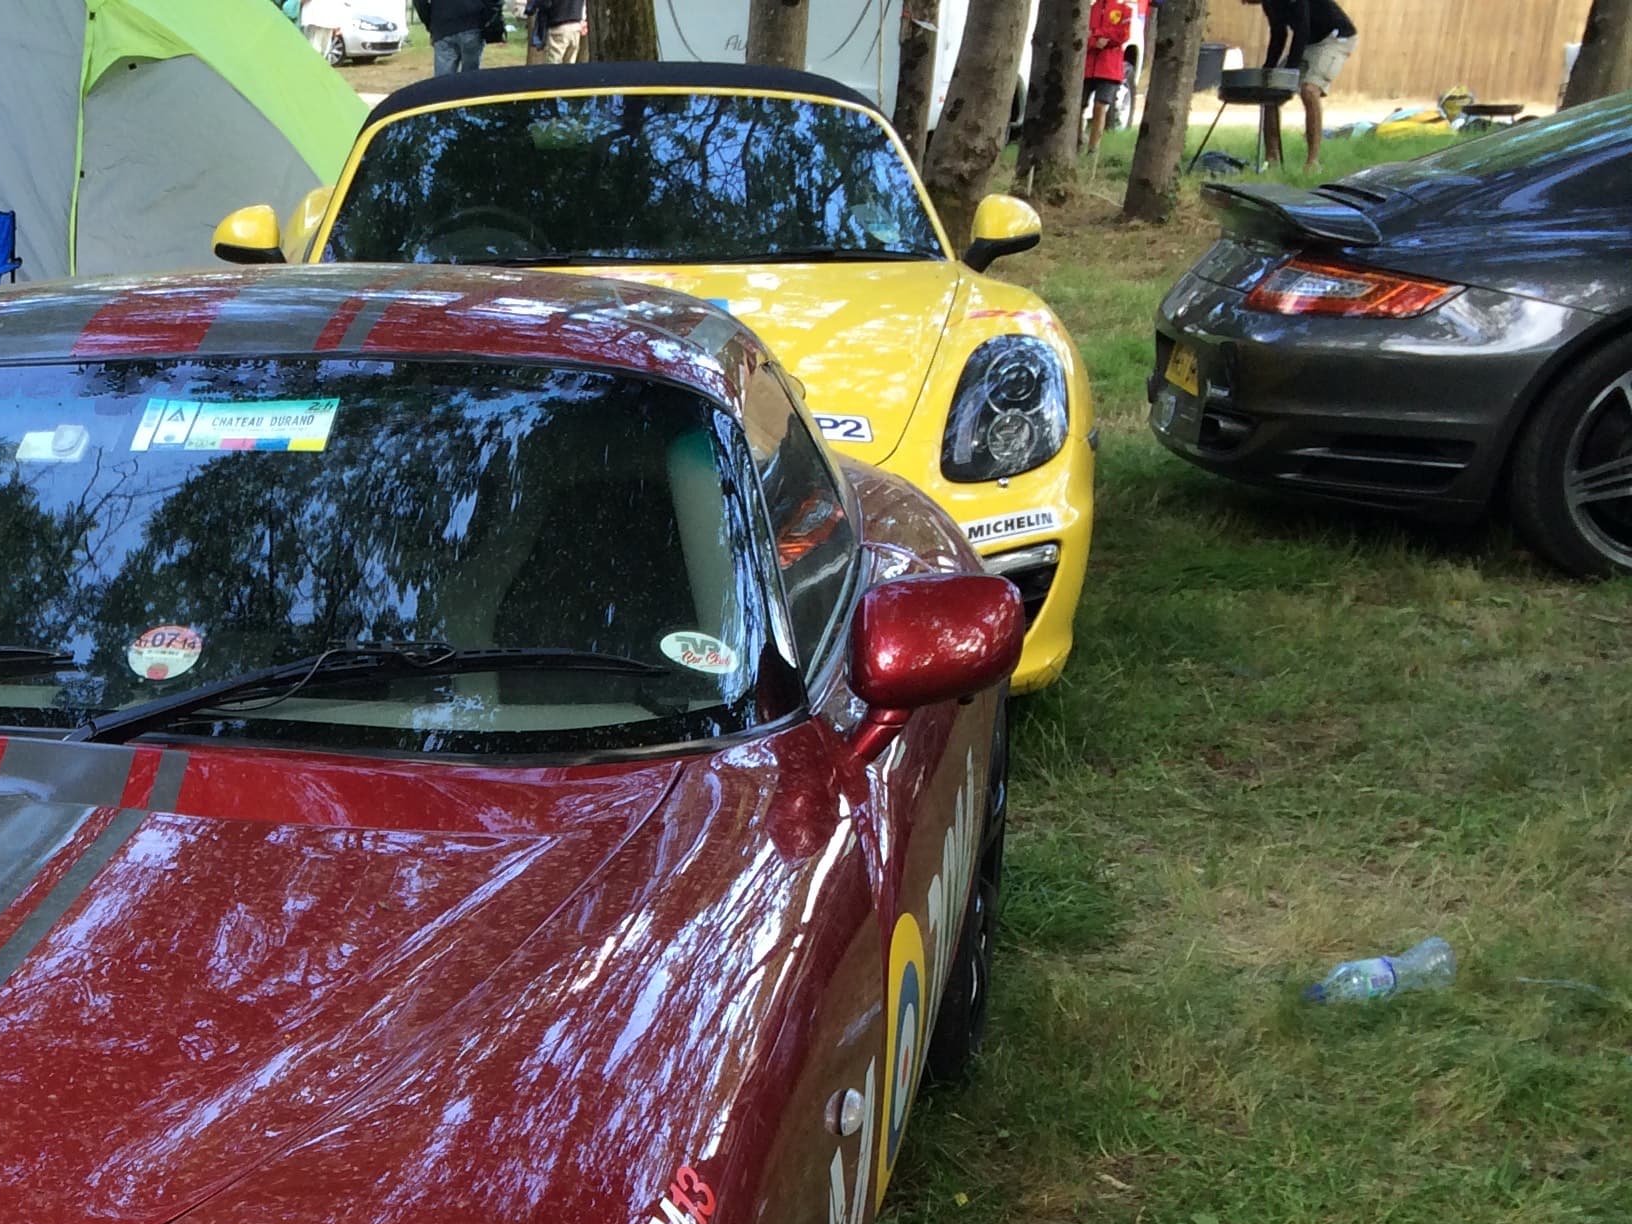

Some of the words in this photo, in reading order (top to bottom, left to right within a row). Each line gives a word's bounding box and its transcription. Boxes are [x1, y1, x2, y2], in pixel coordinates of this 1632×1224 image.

[211, 416, 265, 427] CHATEAU
[270, 415, 315, 427] DURAND
[967, 512, 1054, 541] MICHELIN
[151, 631, 180, 648] 07
